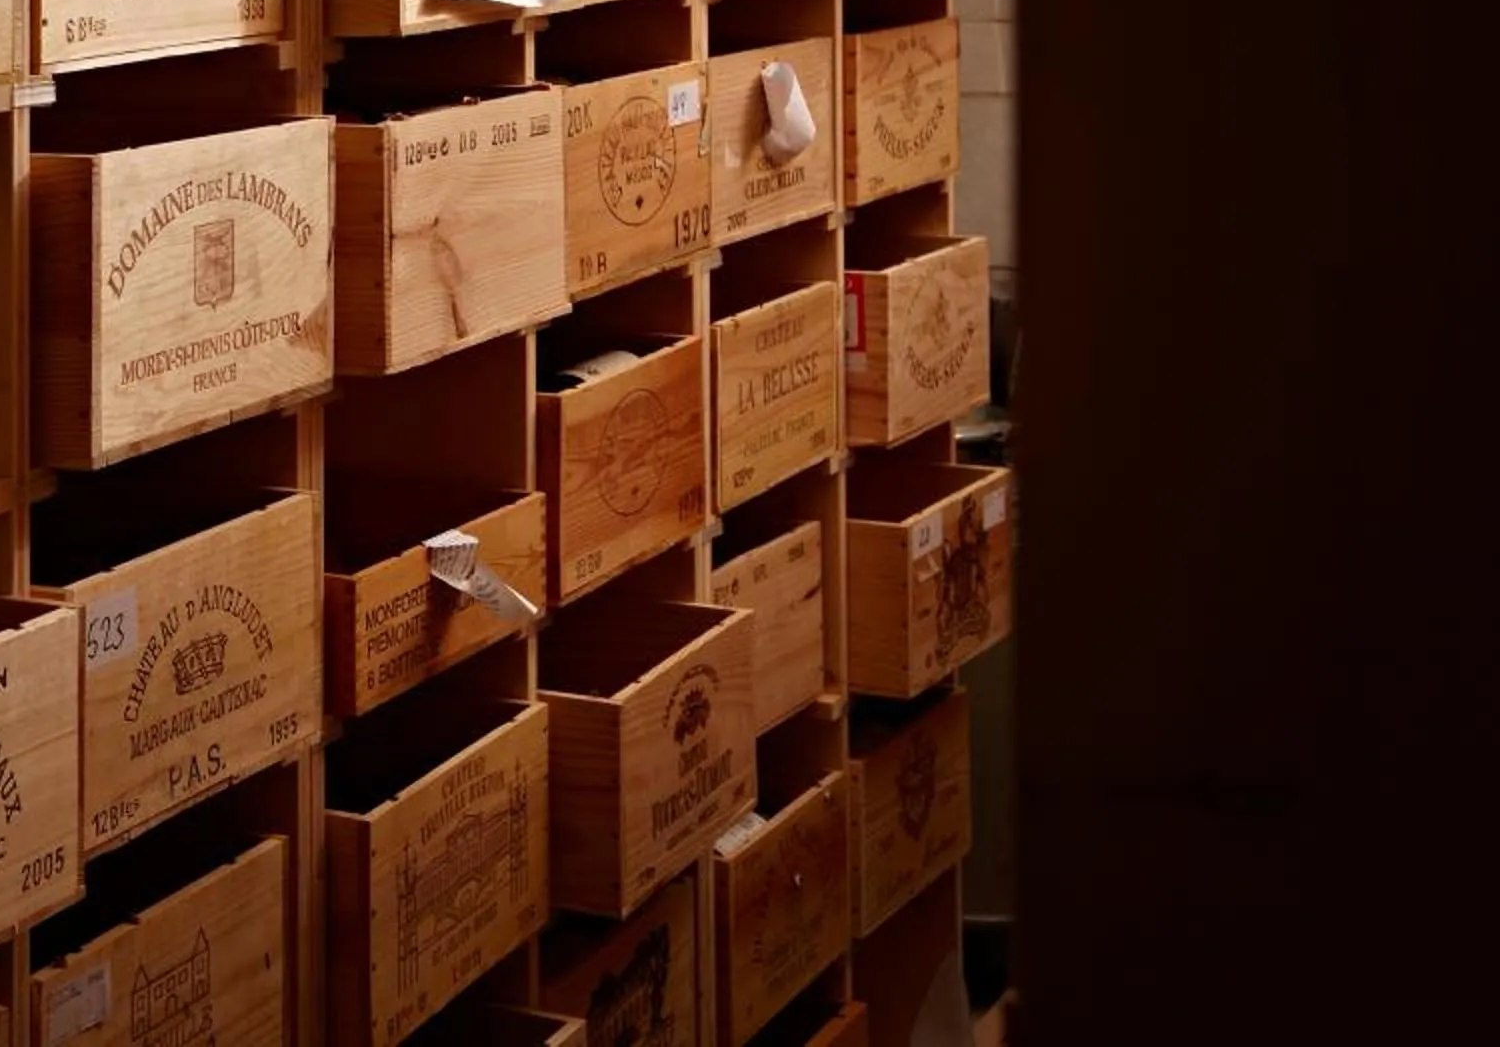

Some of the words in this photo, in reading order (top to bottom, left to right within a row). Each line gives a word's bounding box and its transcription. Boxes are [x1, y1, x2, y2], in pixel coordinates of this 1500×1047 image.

[106, 180, 197, 299] DOMAINE
[197, 178, 224, 207] DES
[226, 171, 313, 249] LAMBRAYS
[673, 203, 711, 250] 1970
[193, 362, 238, 395] FRANCE
[737, 378, 756, 416] LA
[86, 611, 126, 661] 523
[123, 609, 180, 724] CHATEAU
[167, 743, 228, 801] P.A.S.
[20, 846, 66, 893] 2005
